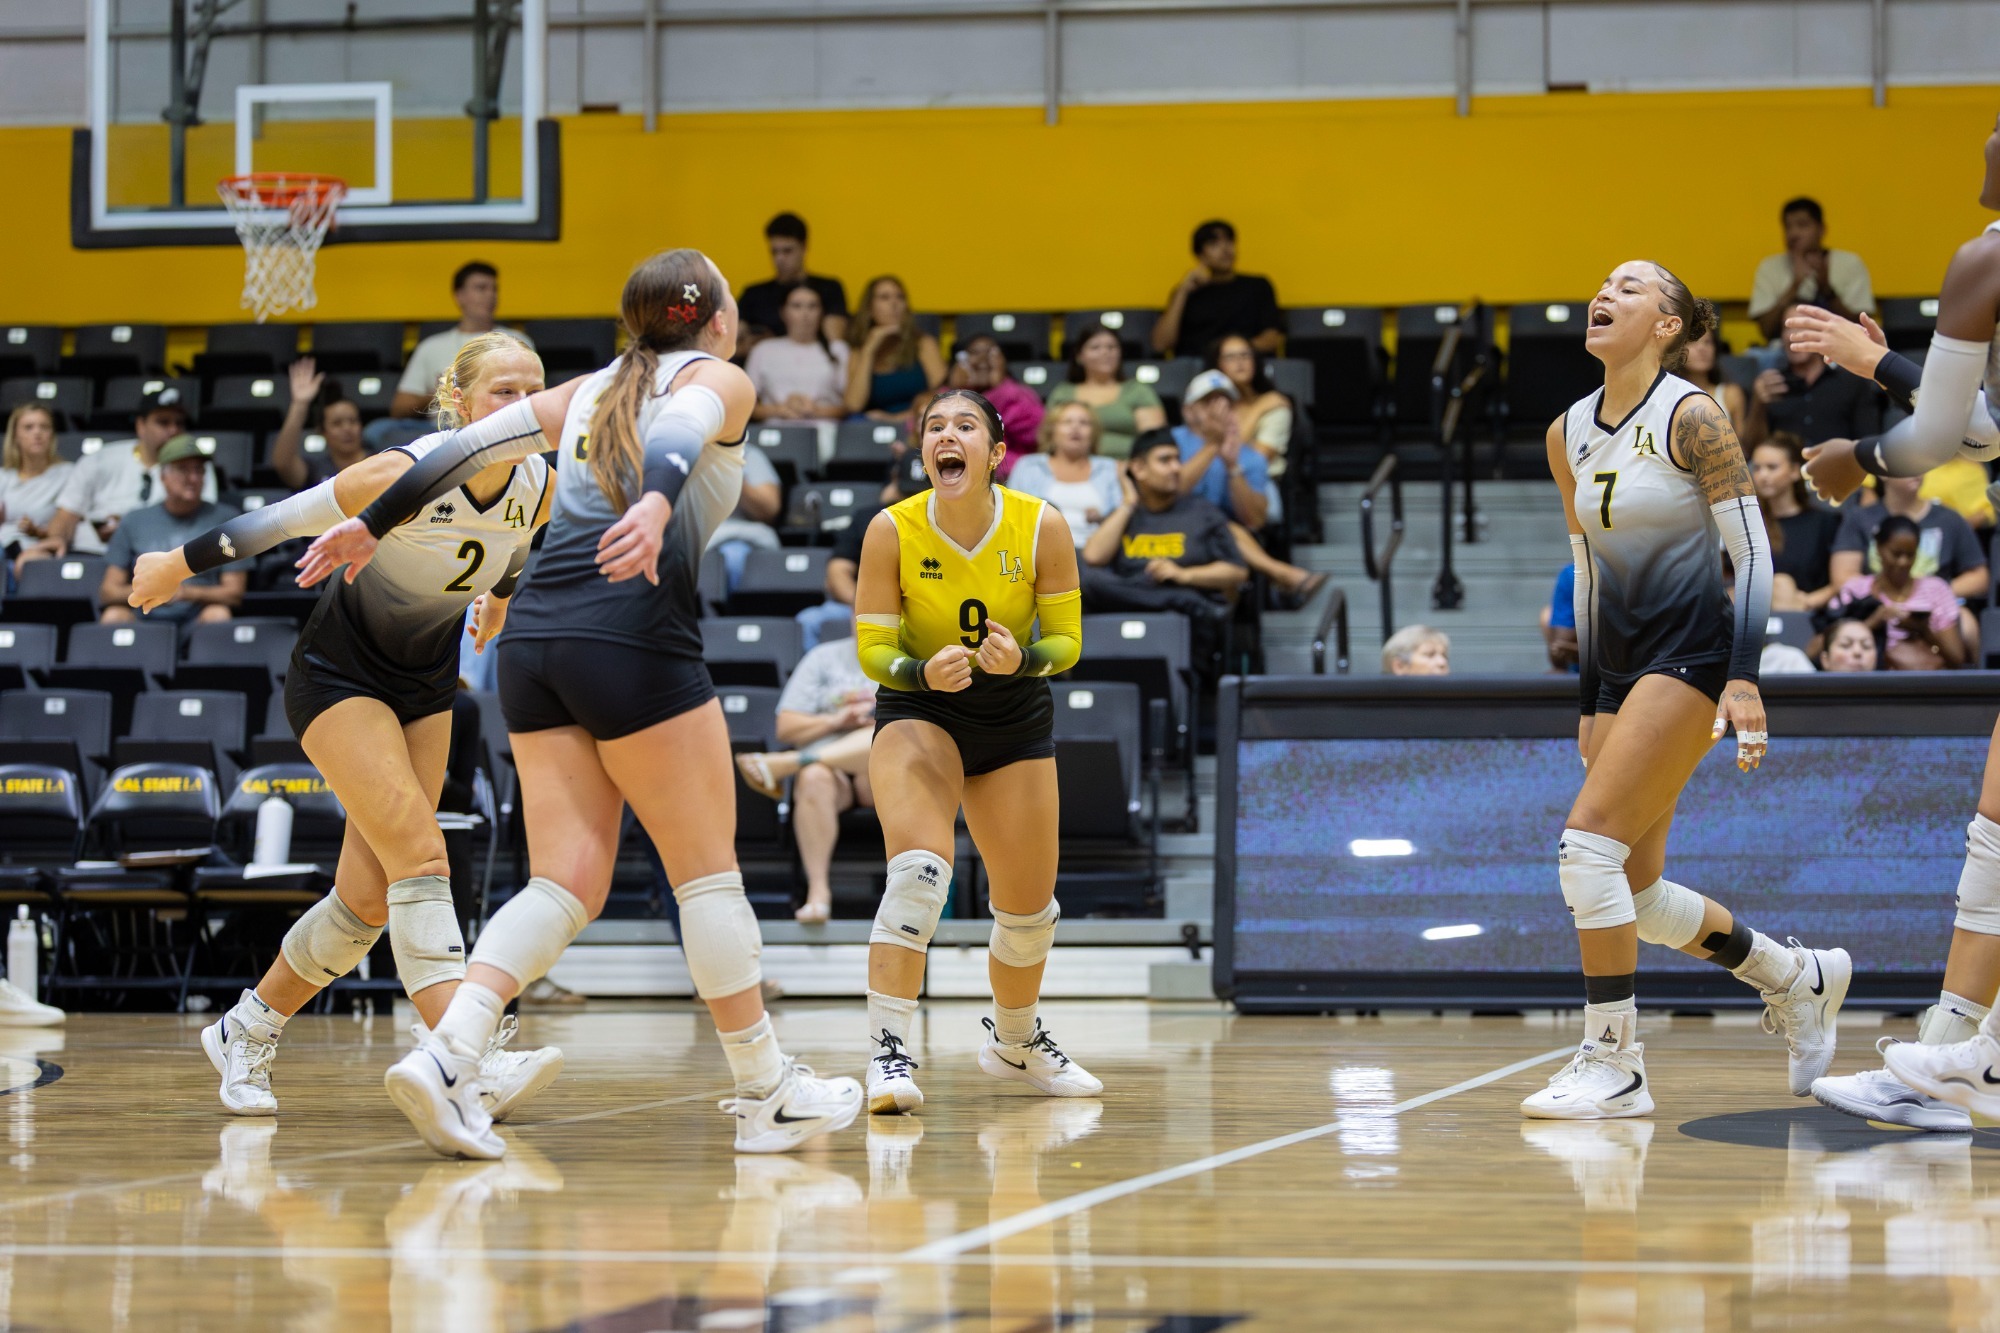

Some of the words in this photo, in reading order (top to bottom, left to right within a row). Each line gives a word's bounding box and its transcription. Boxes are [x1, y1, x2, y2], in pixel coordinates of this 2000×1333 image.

[1632, 425, 1658, 456] LA
[1593, 469, 1618, 530] 7
[430, 516, 453, 524] errea
[503, 498, 525, 528] LA
[443, 538, 485, 593] 2
[920, 571, 943, 580] errea
[997, 550, 1026, 582] LA
[958, 598, 989, 649] 9
[5, 778, 44, 794] STATE
[113, 777, 140, 793] CAL
[142, 776, 182, 793] STATE
[241, 778, 270, 794] CAL
[917, 874, 937, 887] errea
